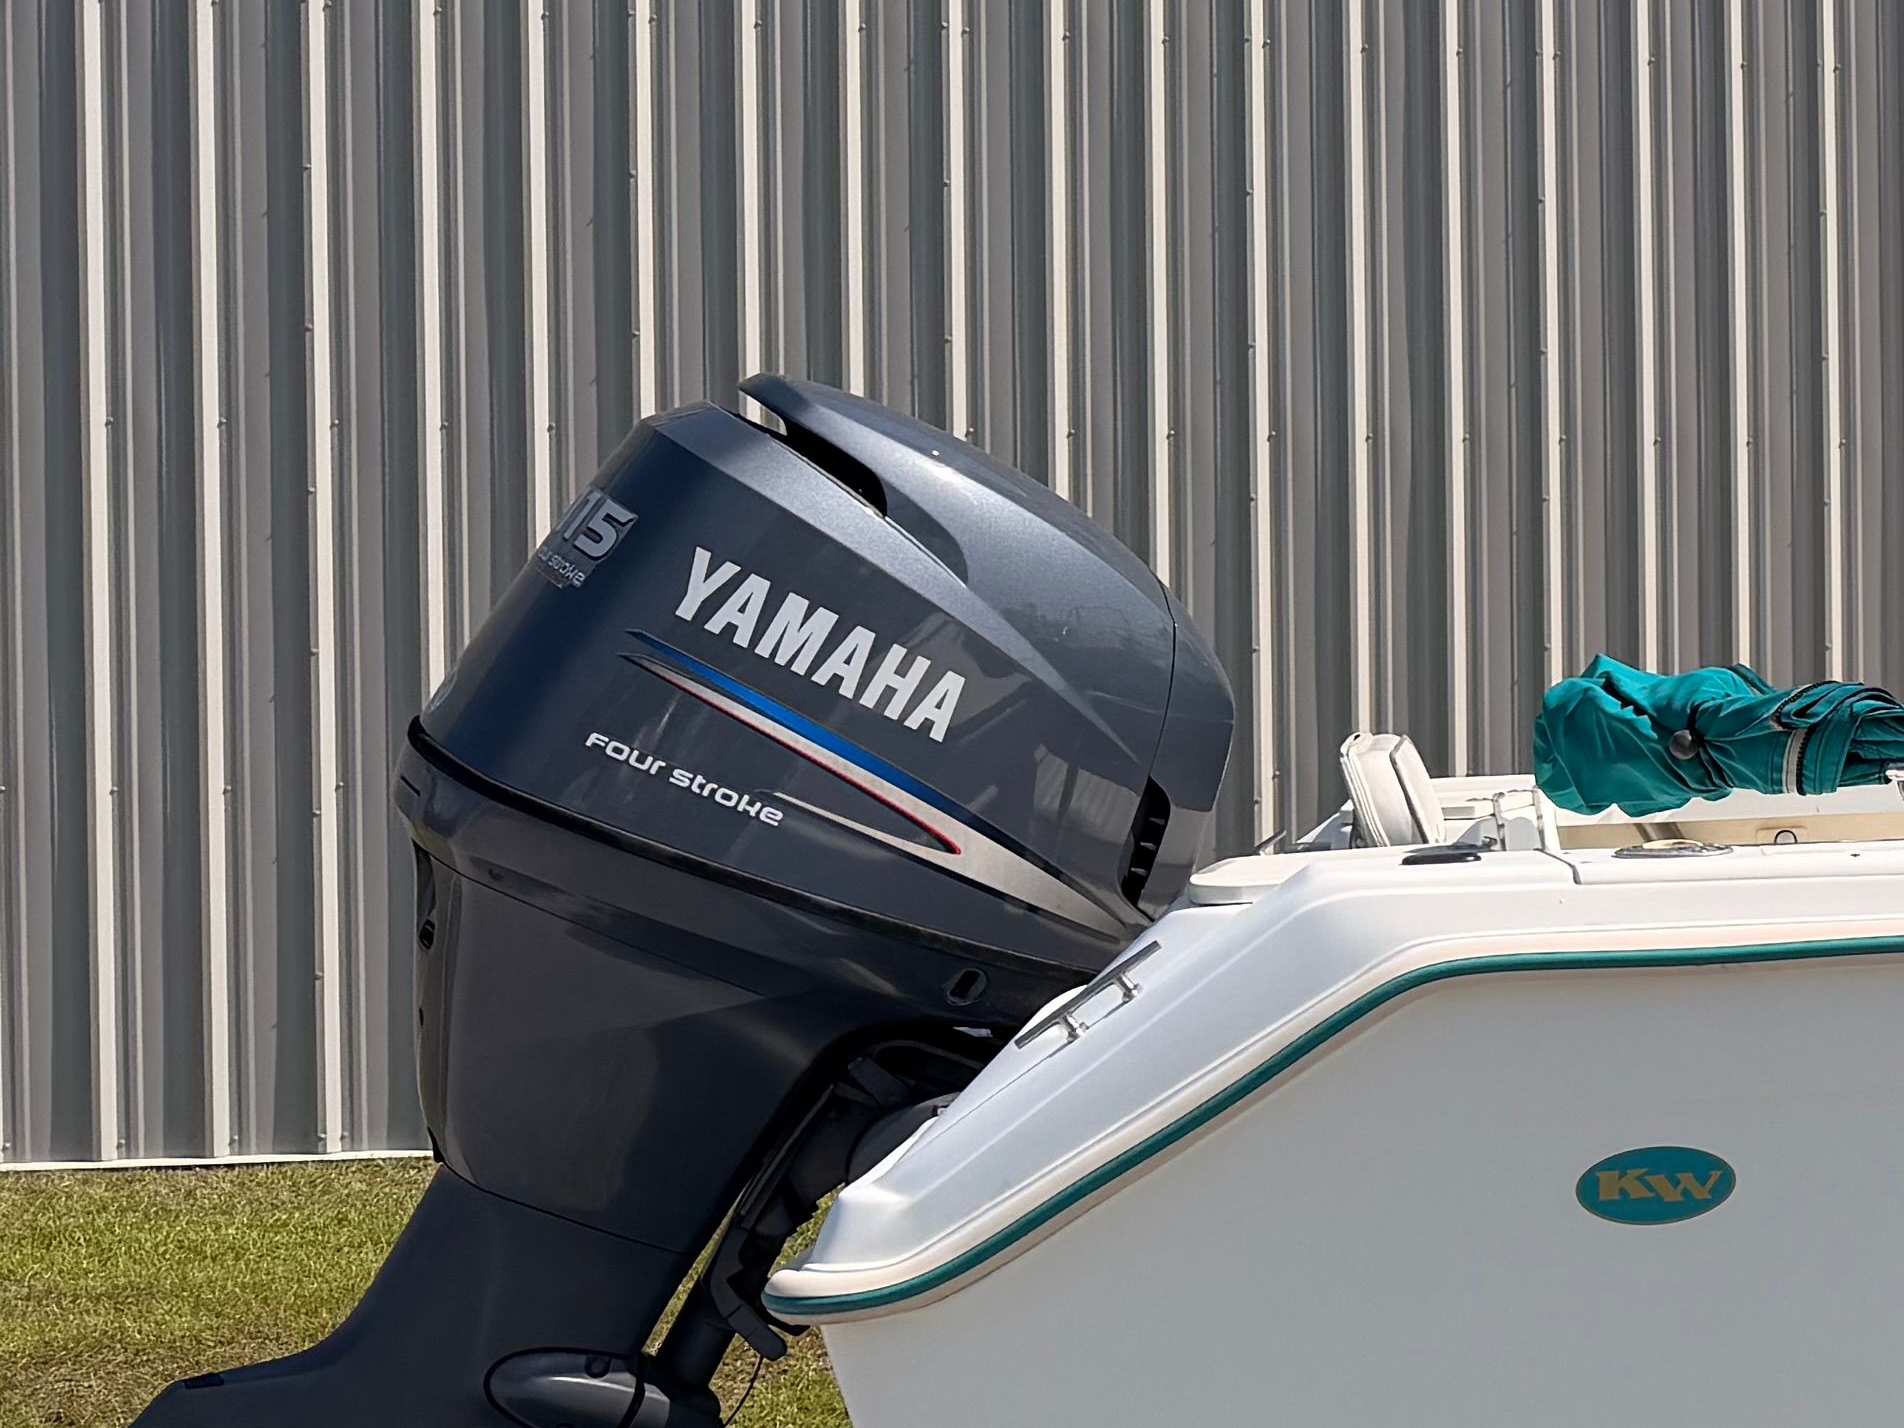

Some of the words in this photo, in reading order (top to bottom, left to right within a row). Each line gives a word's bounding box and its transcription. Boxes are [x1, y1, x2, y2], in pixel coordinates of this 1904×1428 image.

[675, 546, 966, 743] YAMAHA
[669, 768, 784, 827] stroke
[1596, 1168, 1723, 1202] KW
